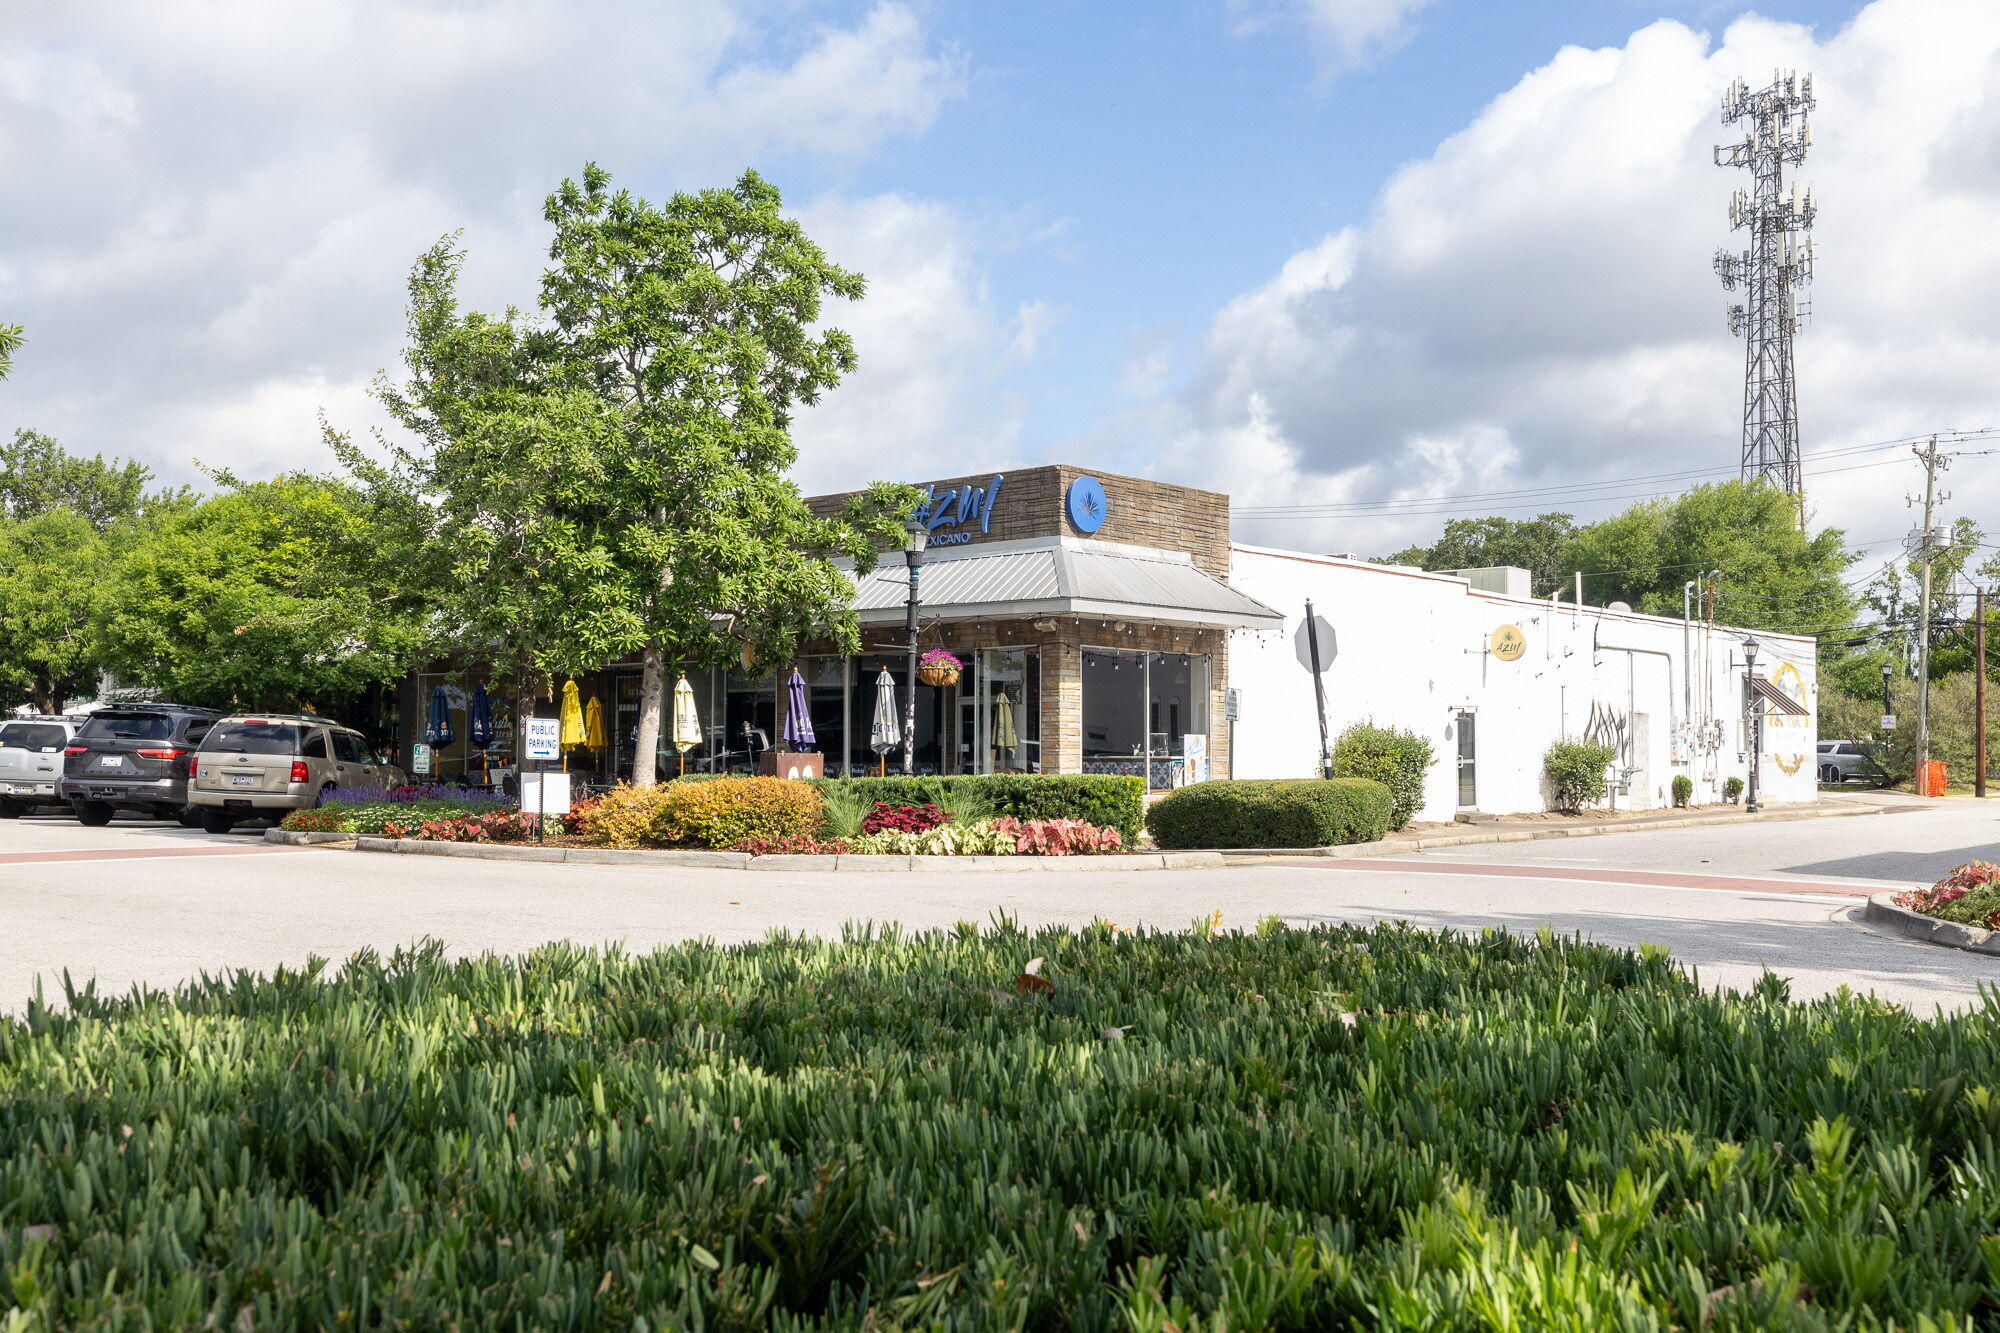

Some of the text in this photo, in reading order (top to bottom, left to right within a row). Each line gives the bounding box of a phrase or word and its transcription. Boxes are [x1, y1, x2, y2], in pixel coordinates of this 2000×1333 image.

[928, 533, 972, 547] XICANO
[531, 725, 555, 735] PUBLIC
[528, 738, 557, 749] PARKING
